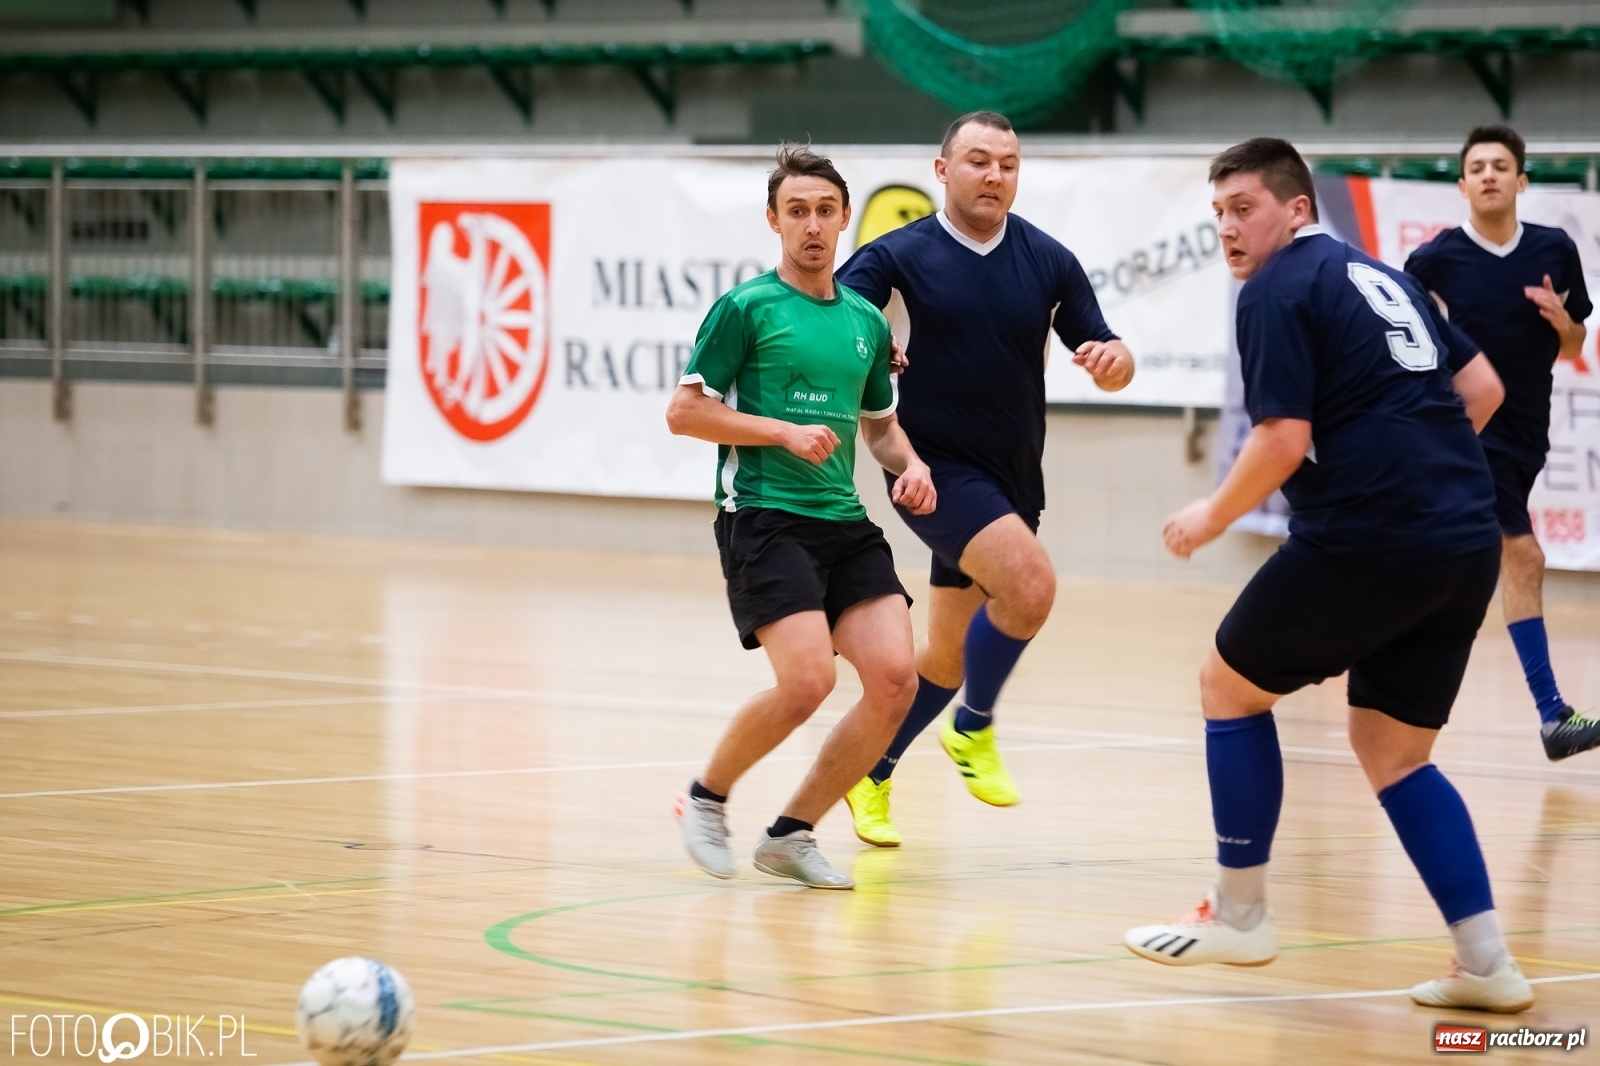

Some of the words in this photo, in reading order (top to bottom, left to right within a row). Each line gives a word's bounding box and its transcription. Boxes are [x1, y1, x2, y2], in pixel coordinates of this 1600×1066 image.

[1347, 262, 1438, 371] 9
[793, 391, 807, 400] RH
[809, 393, 828, 402] BUD
